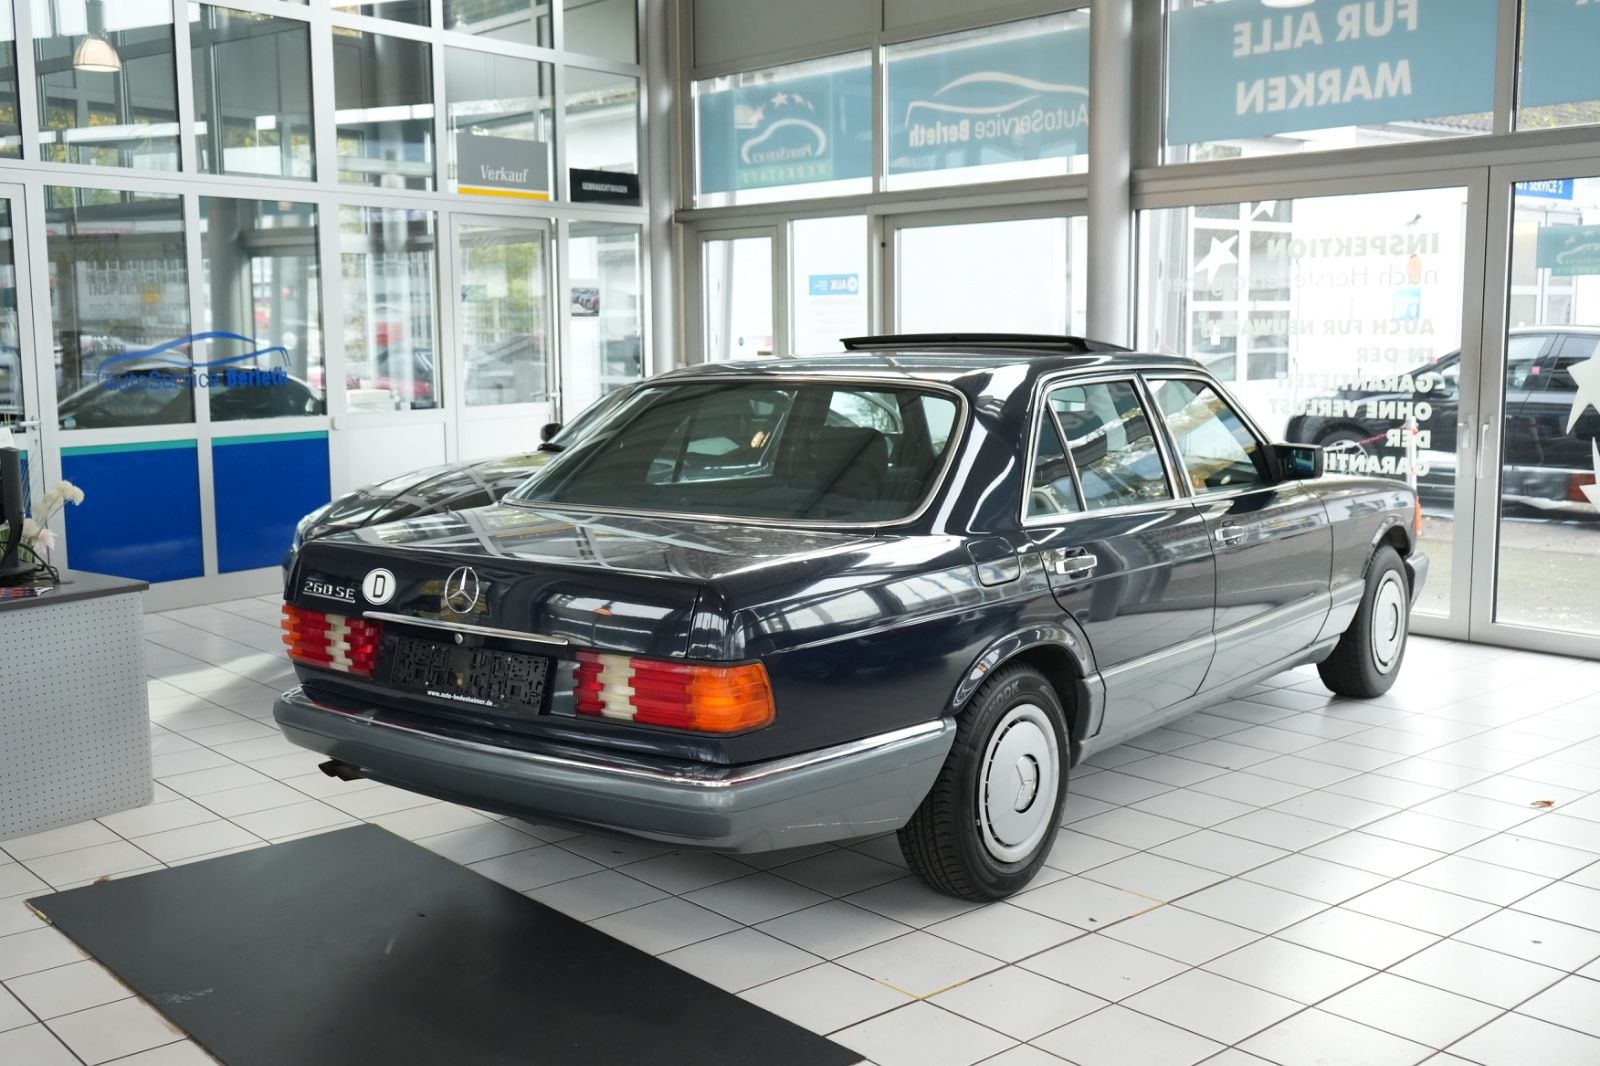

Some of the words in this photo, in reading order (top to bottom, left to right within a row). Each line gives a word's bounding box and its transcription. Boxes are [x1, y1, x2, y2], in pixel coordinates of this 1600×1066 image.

[480, 164, 529, 184] Verkauf
[581, 181, 628, 195] GEBRAUCHTWAGEN
[304, 580, 333, 596] 260
[334, 585, 356, 600] SE
[372, 574, 386, 599] D
